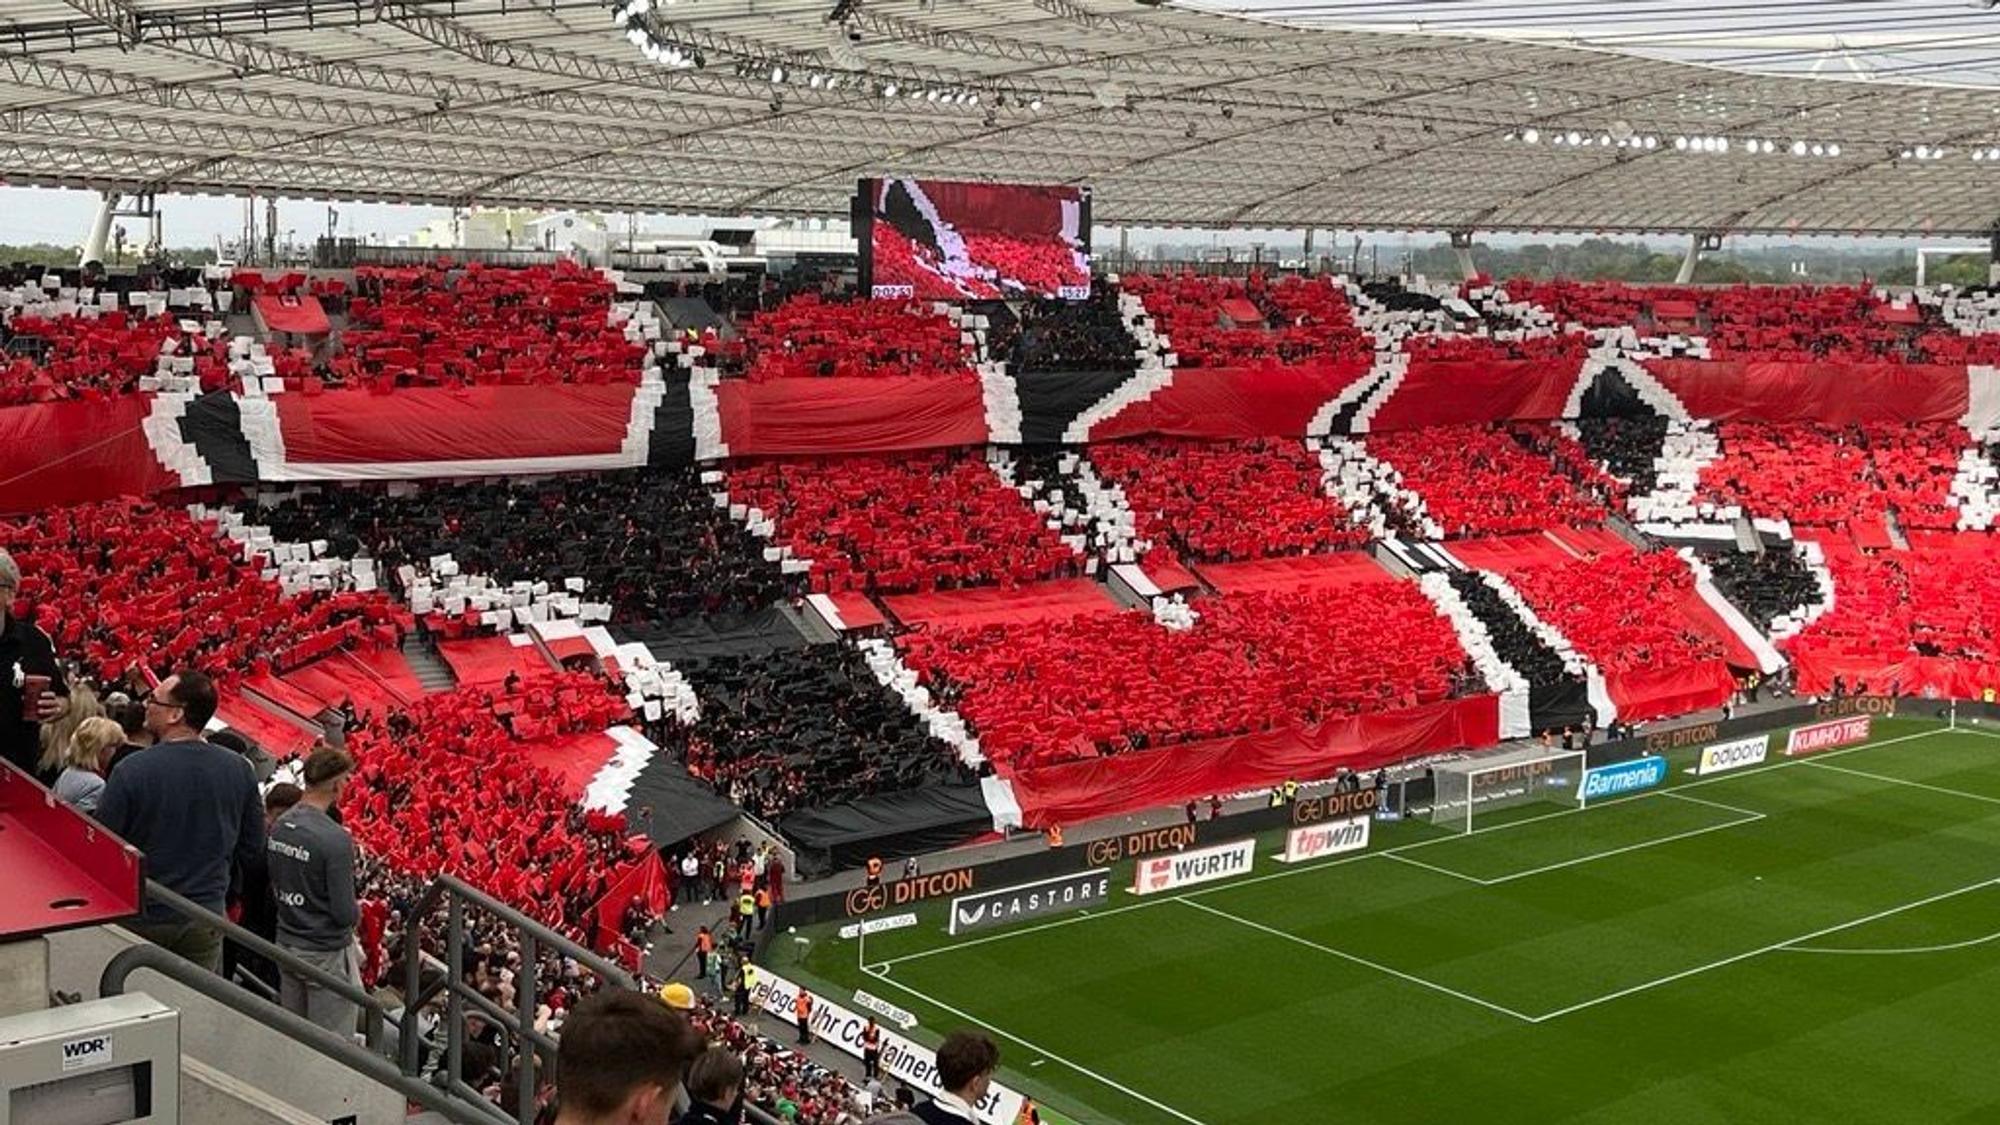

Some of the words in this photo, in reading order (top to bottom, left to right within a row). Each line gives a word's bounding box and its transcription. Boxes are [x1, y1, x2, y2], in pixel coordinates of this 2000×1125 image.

[1673, 724, 1717, 746] DITCON
[1793, 725, 1841, 752] KUMHO
[1843, 719, 1870, 742] TIRE
[1587, 762, 1657, 794] Barmenia
[1328, 790, 1376, 816] DITCO
[1128, 825, 1196, 856] DITCON
[1297, 824, 1364, 857] tipwin
[1175, 848, 1244, 881] WÜRTH
[895, 868, 973, 904] DITCON
[991, 878, 1109, 919] CASTORE
[810, 1003, 842, 1034] Ihr
[64, 1038, 105, 1058] WDR
